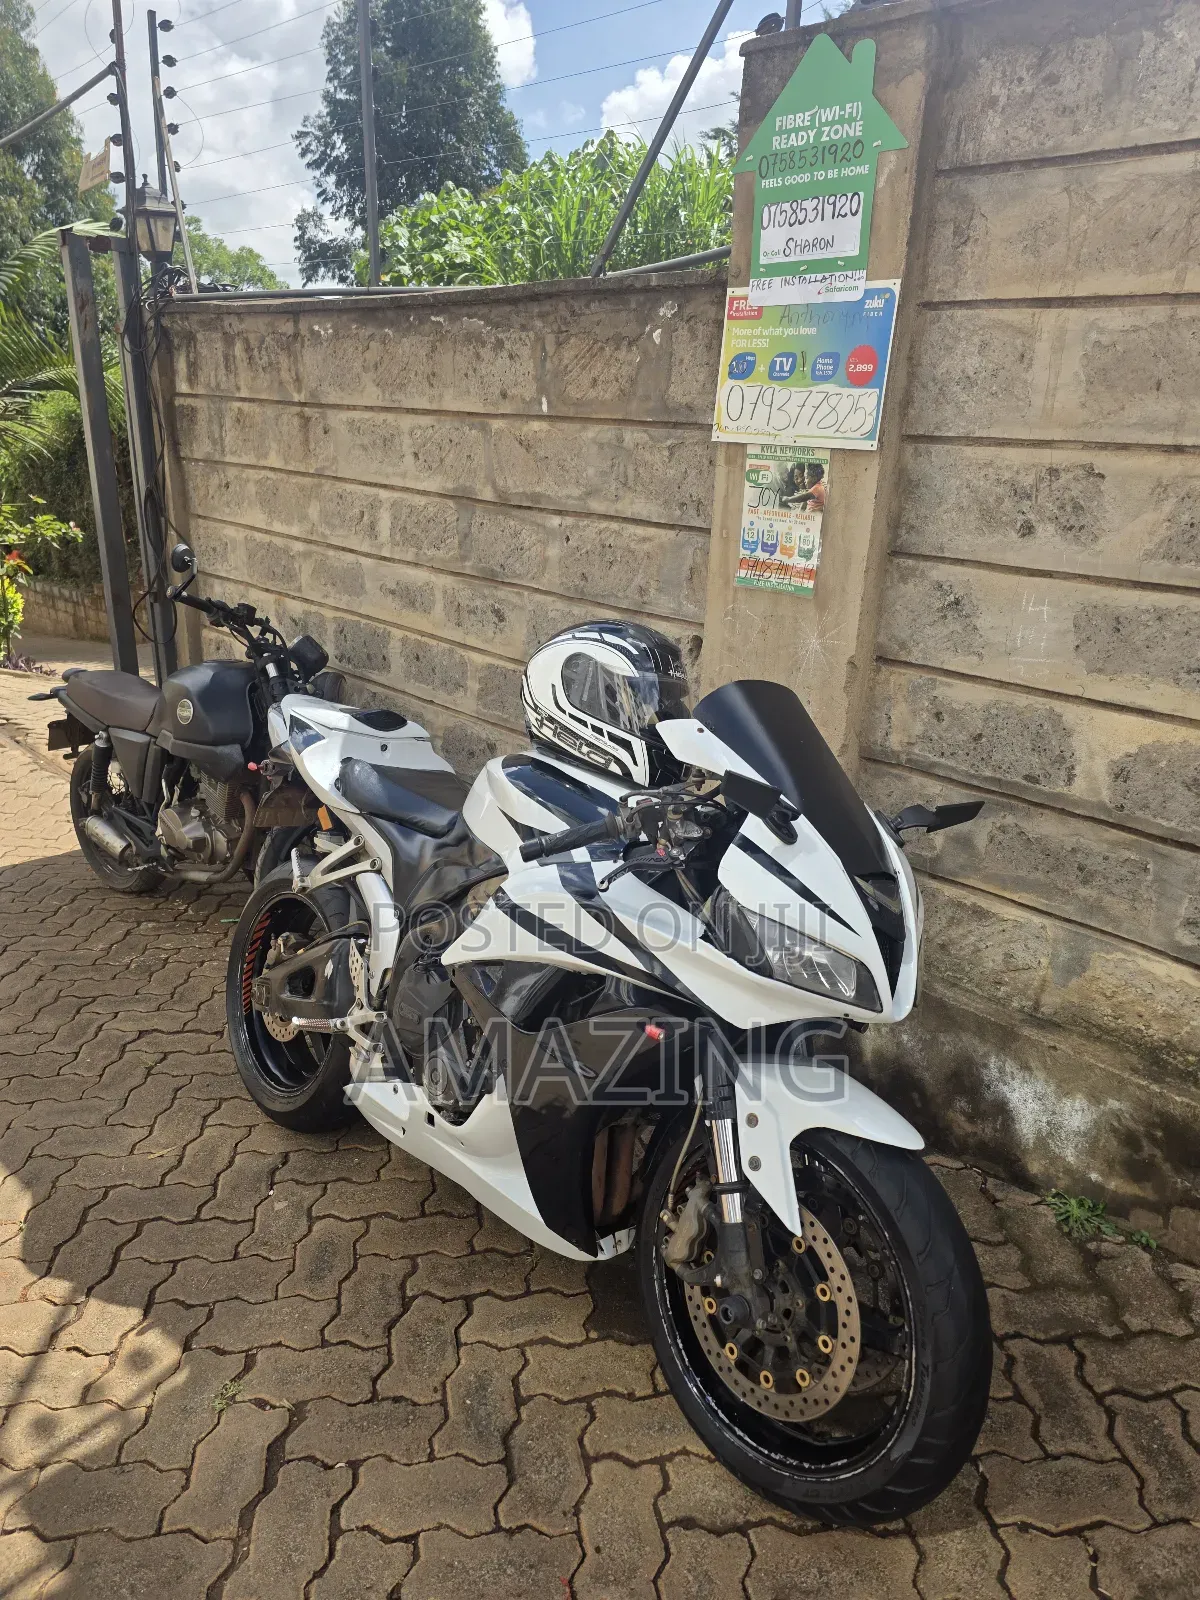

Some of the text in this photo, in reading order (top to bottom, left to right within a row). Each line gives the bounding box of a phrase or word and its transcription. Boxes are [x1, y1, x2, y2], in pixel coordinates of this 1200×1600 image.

[775, 101, 863, 131] FIBRE (WI-FI)
[772, 121, 864, 150] READY ZONE
[758, 139, 865, 179] 0758531920
[761, 164, 870, 189] FEELS GOOD TO BE HOME
[761, 192, 861, 230] 0758531920
[783, 235, 835, 257] SHARON
[751, 279, 774, 293] FREE
[824, 284, 859, 293] Safaricom
[732, 299, 759, 310] FRE
[732, 325, 817, 338] More of what you love
[731, 338, 769, 348] FOR LESS!
[774, 357, 793, 371] TV
[848, 364, 874, 373] 2,899
[726, 384, 880, 436] 0793778253
[760, 445, 816, 457] KYLA NETWORKS
[747, 485, 781, 509] JOY
[784, 536, 793, 544] 35
